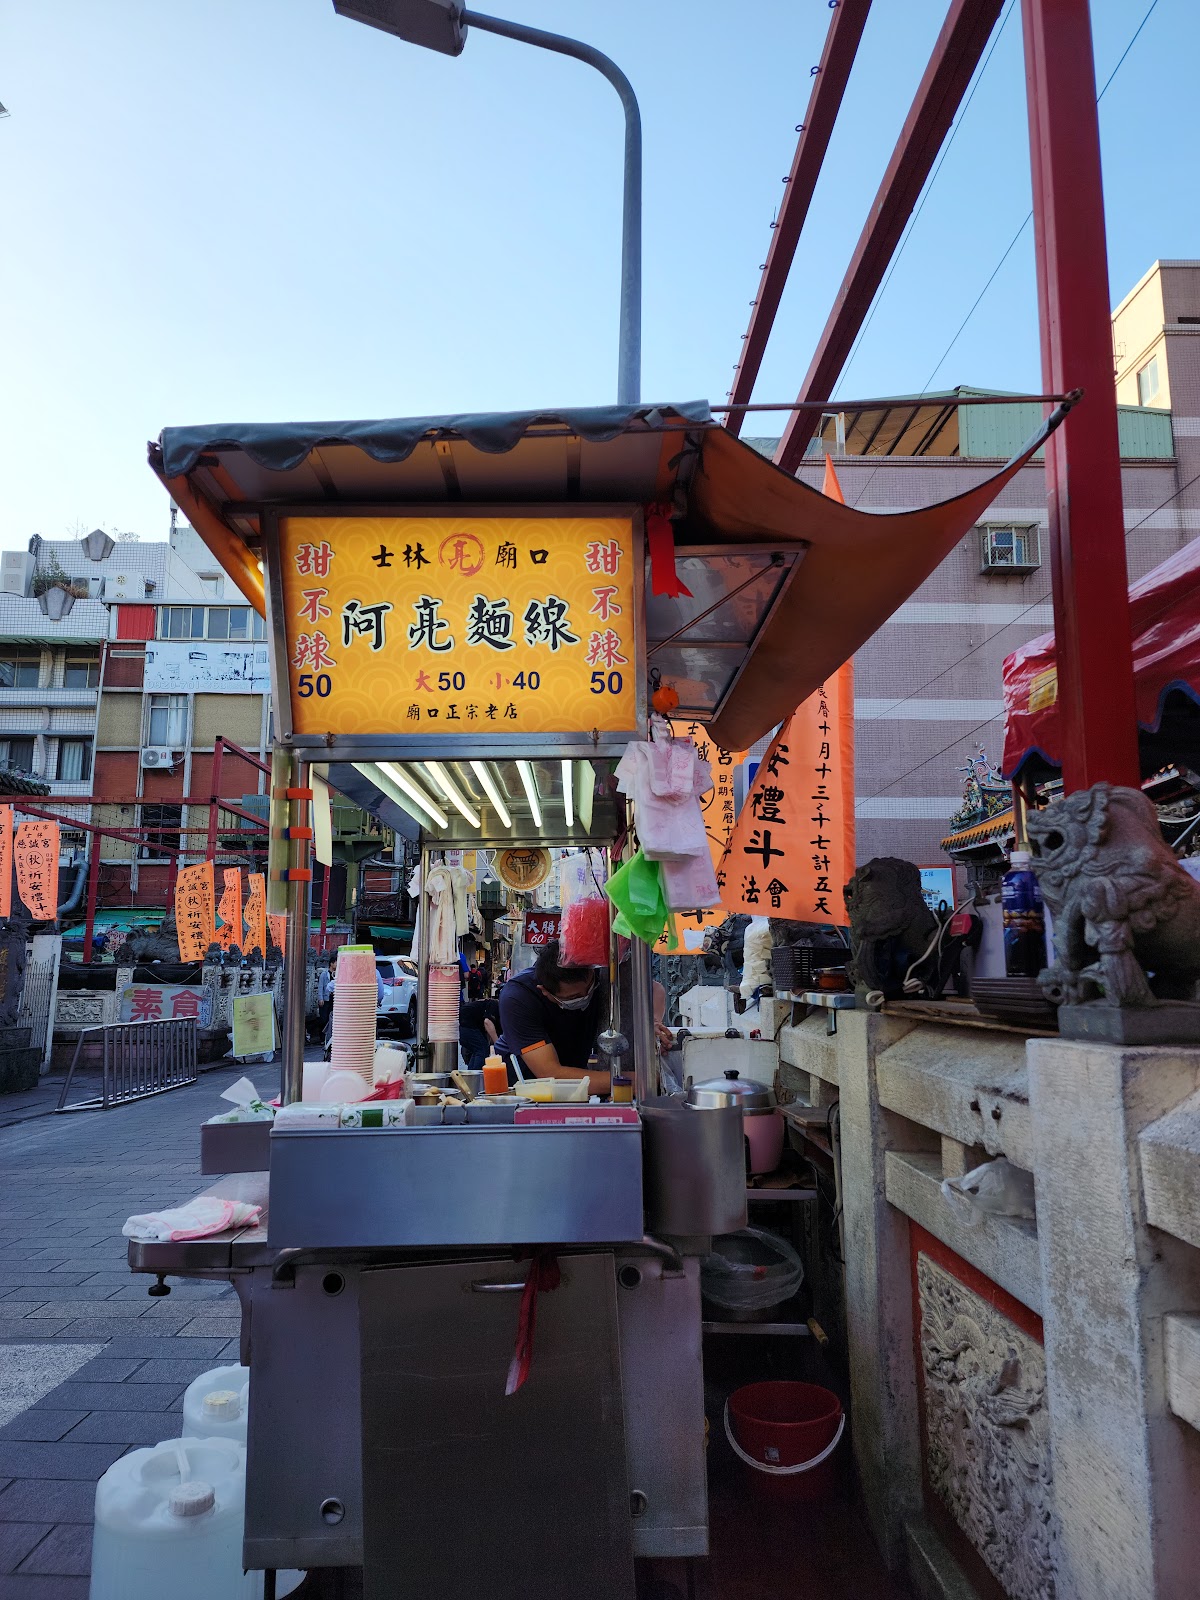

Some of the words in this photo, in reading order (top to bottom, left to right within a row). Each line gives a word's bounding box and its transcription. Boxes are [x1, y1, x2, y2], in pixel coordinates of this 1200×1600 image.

[371, 543, 431, 570] 士林
[495, 541, 549, 569] 廟口
[293, 540, 336, 671] 甜不辣
[585, 539, 627, 669] 甜不辣
[342, 595, 581, 652] 阿亮麵線
[298, 673, 332, 698] 50
[590, 671, 623, 695] 50
[406, 703, 518, 721] 廟口正宗老店
[29, 854, 40, 865] 秋
[188, 897, 199, 906] 秋
[741, 875, 790, 909] 法會
[130, 988, 203, 1024] 素食
